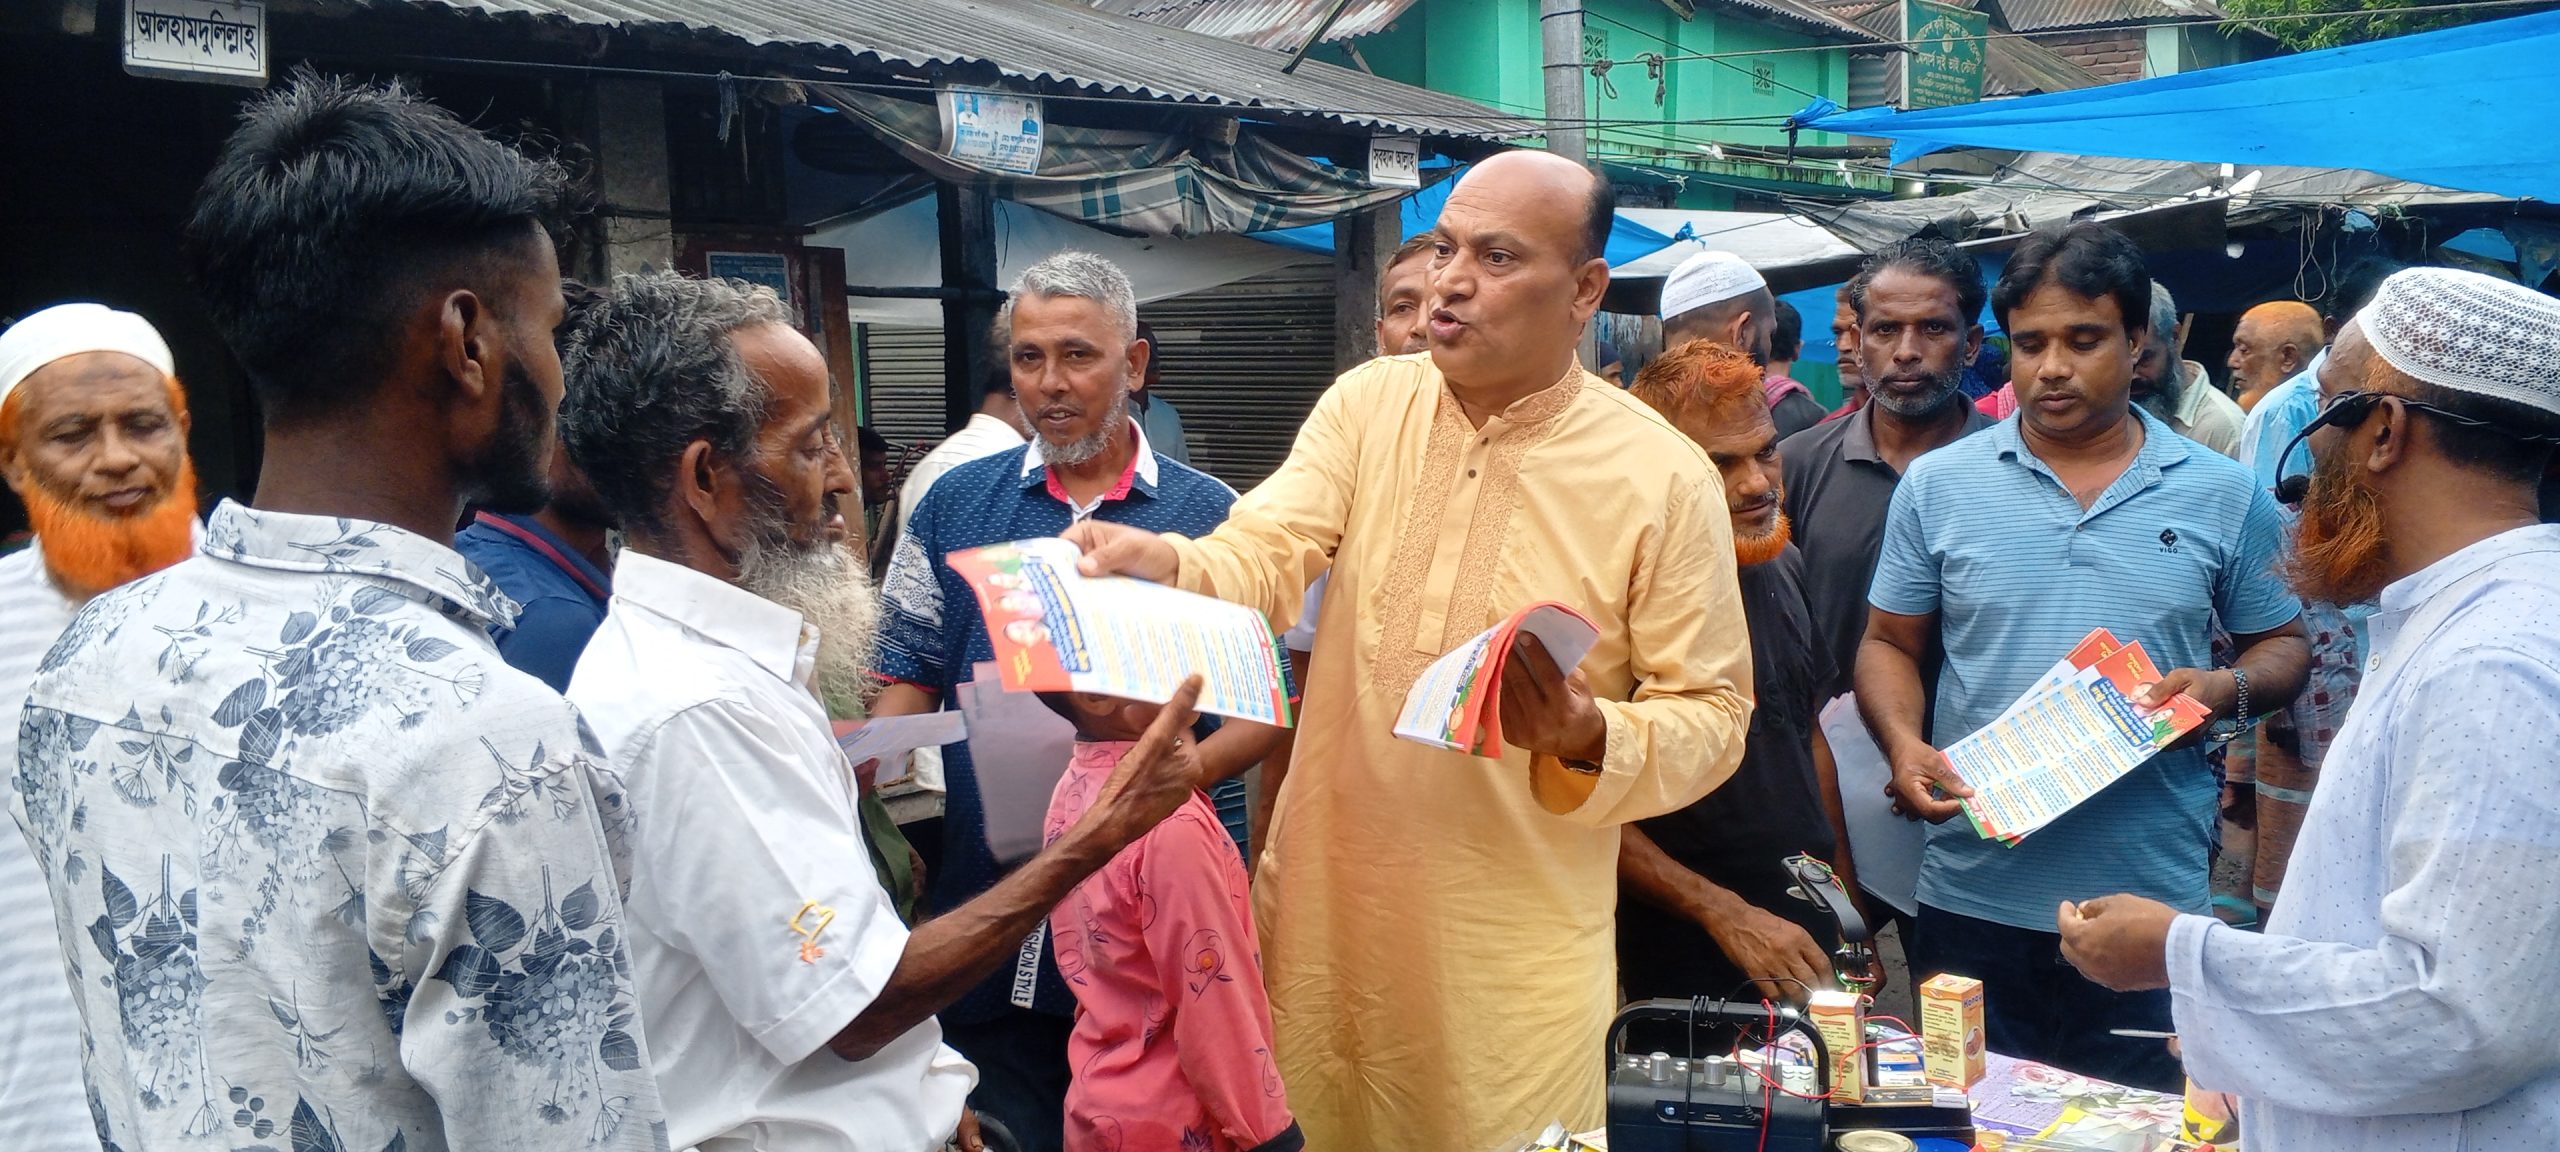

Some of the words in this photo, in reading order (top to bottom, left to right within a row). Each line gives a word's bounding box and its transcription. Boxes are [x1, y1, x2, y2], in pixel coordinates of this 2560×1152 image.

[135, 8, 257, 61] আলহামদুলিল্লাহ্
[1020, 920, 1044, 969] SHION
[1013, 970, 1033, 1002] STYLE
